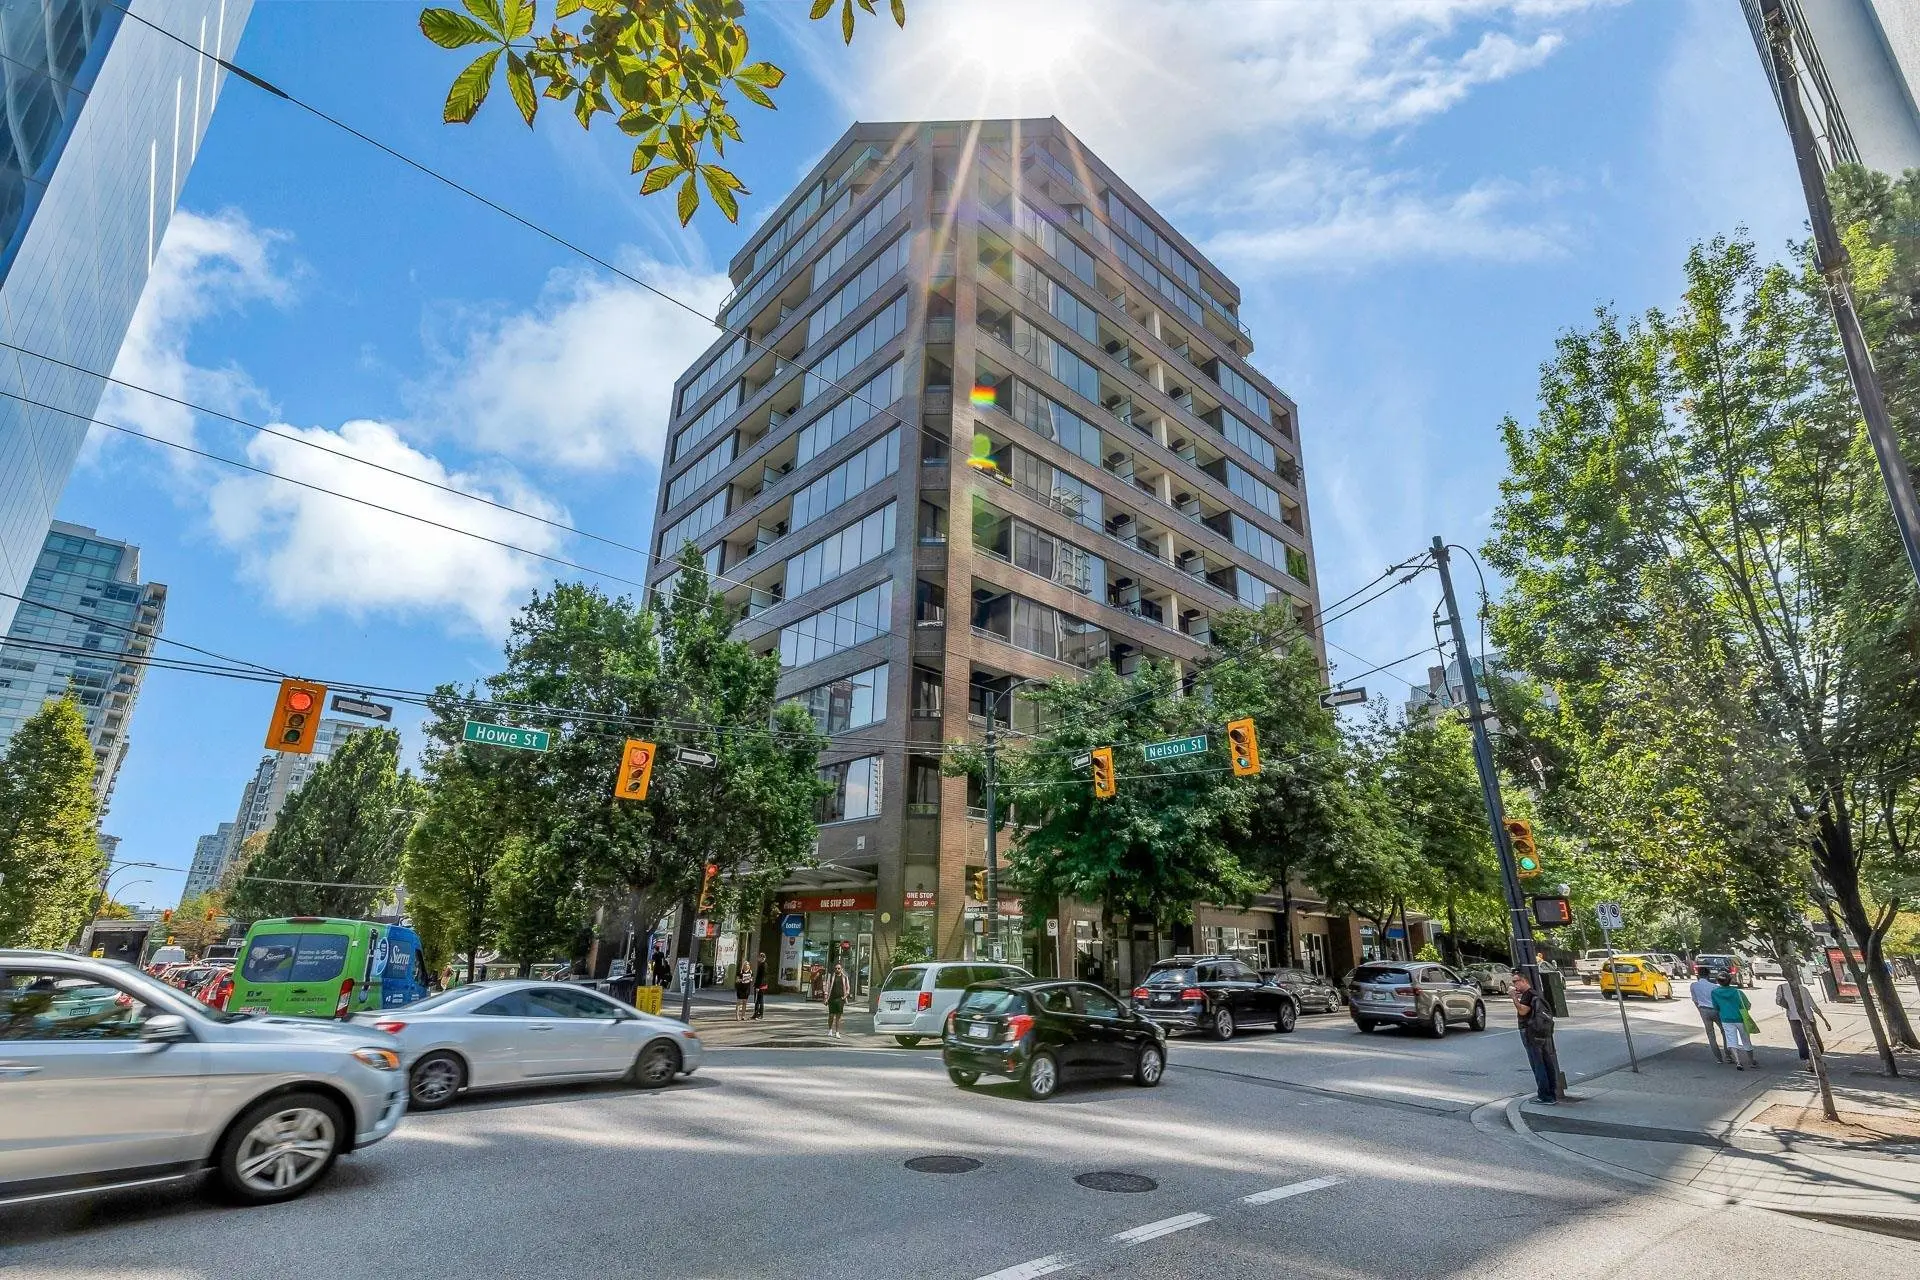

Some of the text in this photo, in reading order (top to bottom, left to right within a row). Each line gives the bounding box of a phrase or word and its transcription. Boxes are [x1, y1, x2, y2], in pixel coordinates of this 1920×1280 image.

[475, 726, 538, 747] Howe St
[1149, 738, 1202, 757] Nelson St
[820, 898, 856, 908] ONE STOP SHOP
[1559, 900, 1569, 920] 3
